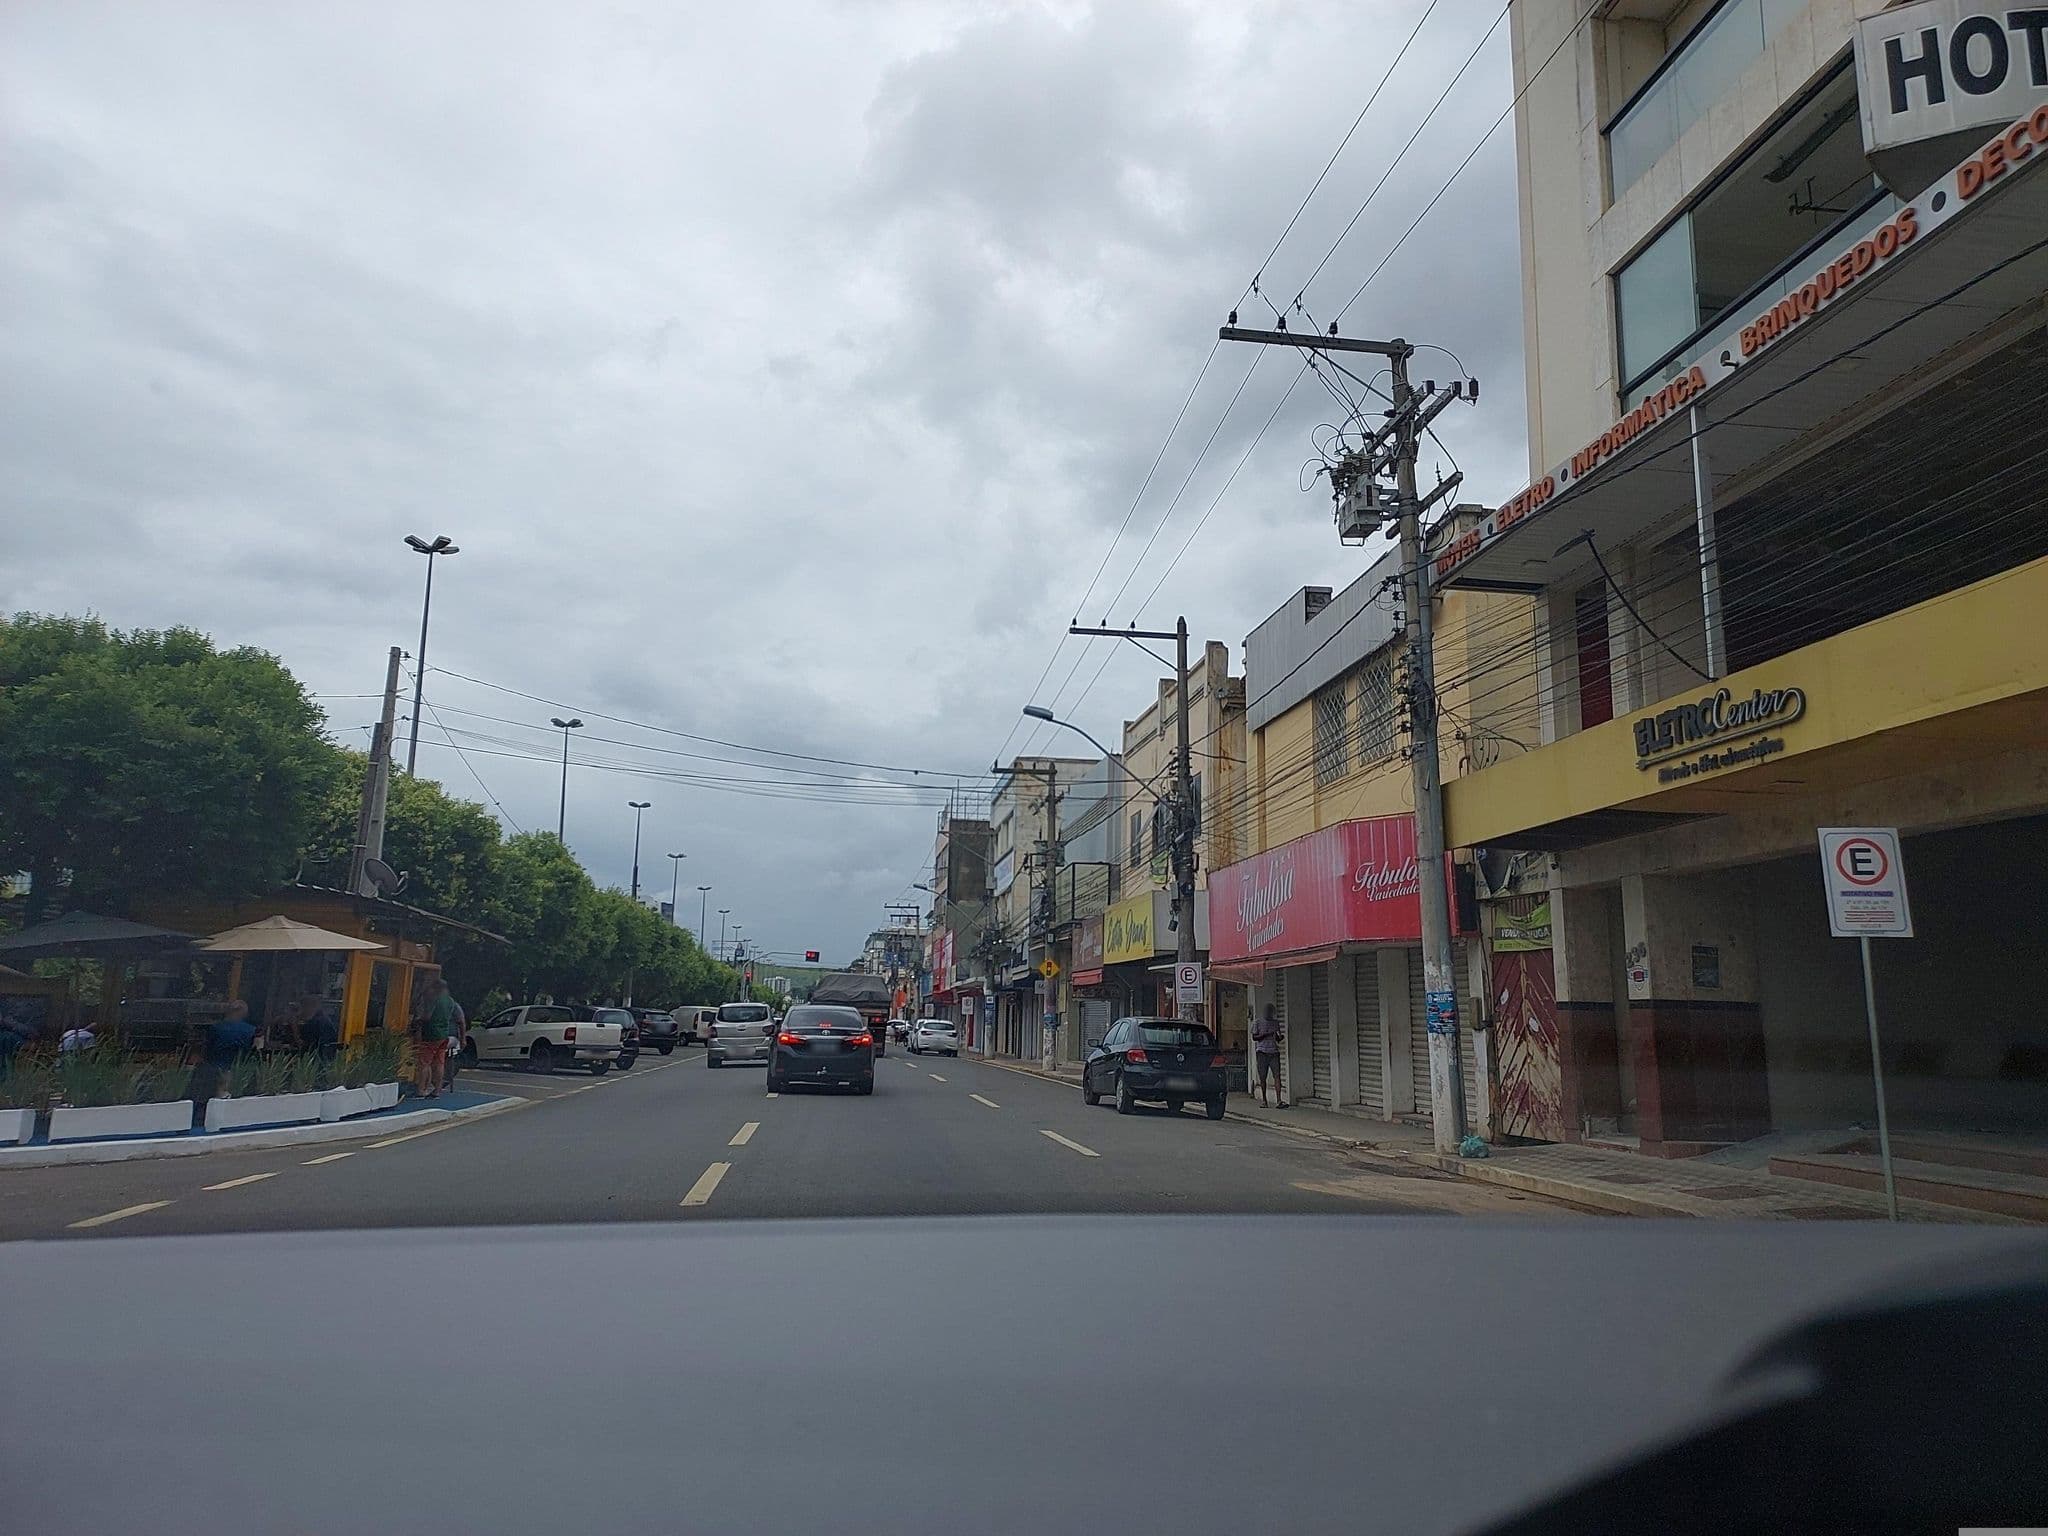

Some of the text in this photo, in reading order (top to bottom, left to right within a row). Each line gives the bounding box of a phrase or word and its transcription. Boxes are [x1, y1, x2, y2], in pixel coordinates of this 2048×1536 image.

[1884, 10, 2048, 114] HOT
[1496, 476, 1555, 532] ELETRO
[1571, 366, 1706, 478] INFORMÁTICA
[1740, 208, 1918, 356] BRINQUEDOS
[1237, 858, 1295, 932] Fabulosa
[1849, 848, 1875, 875] E
[1185, 970, 1192, 980] E
